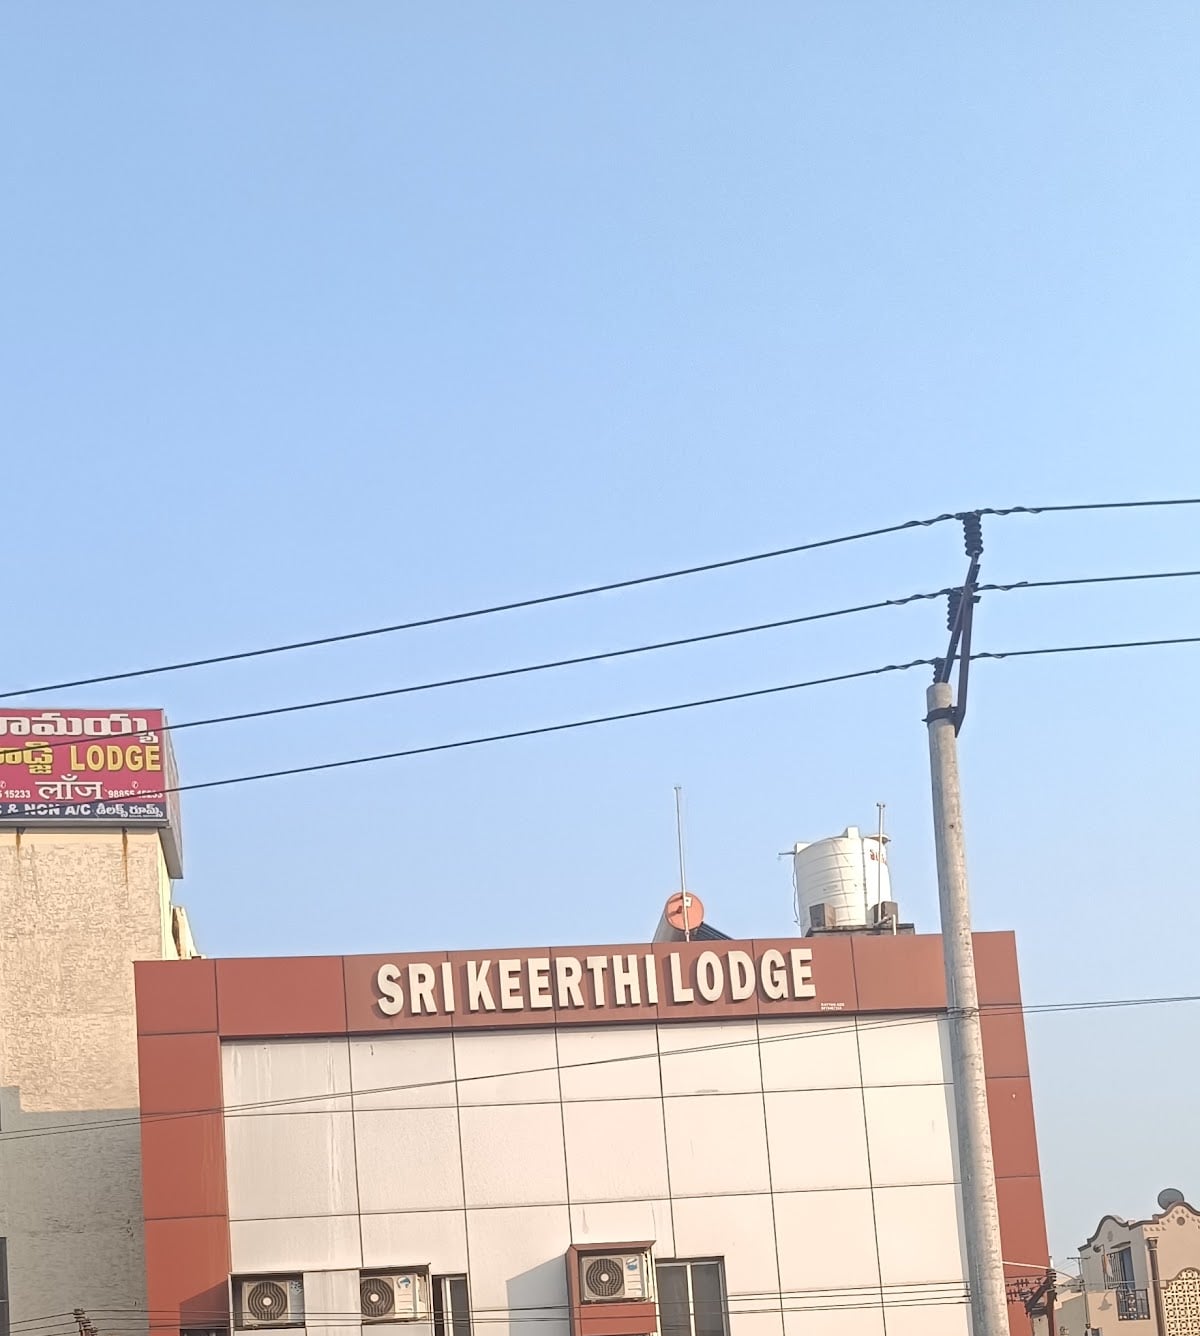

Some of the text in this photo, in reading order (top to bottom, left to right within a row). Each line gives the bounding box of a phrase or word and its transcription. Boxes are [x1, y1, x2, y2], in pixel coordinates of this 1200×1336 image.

[70, 744, 161, 771] LODGE
[4, 789, 31, 799] 15233
[7, 803, 19, 815] &
[24, 803, 60, 815] NON
[65, 803, 91, 816] A/C
[376, 948, 817, 1016] SRI KEERTHI LODGE
